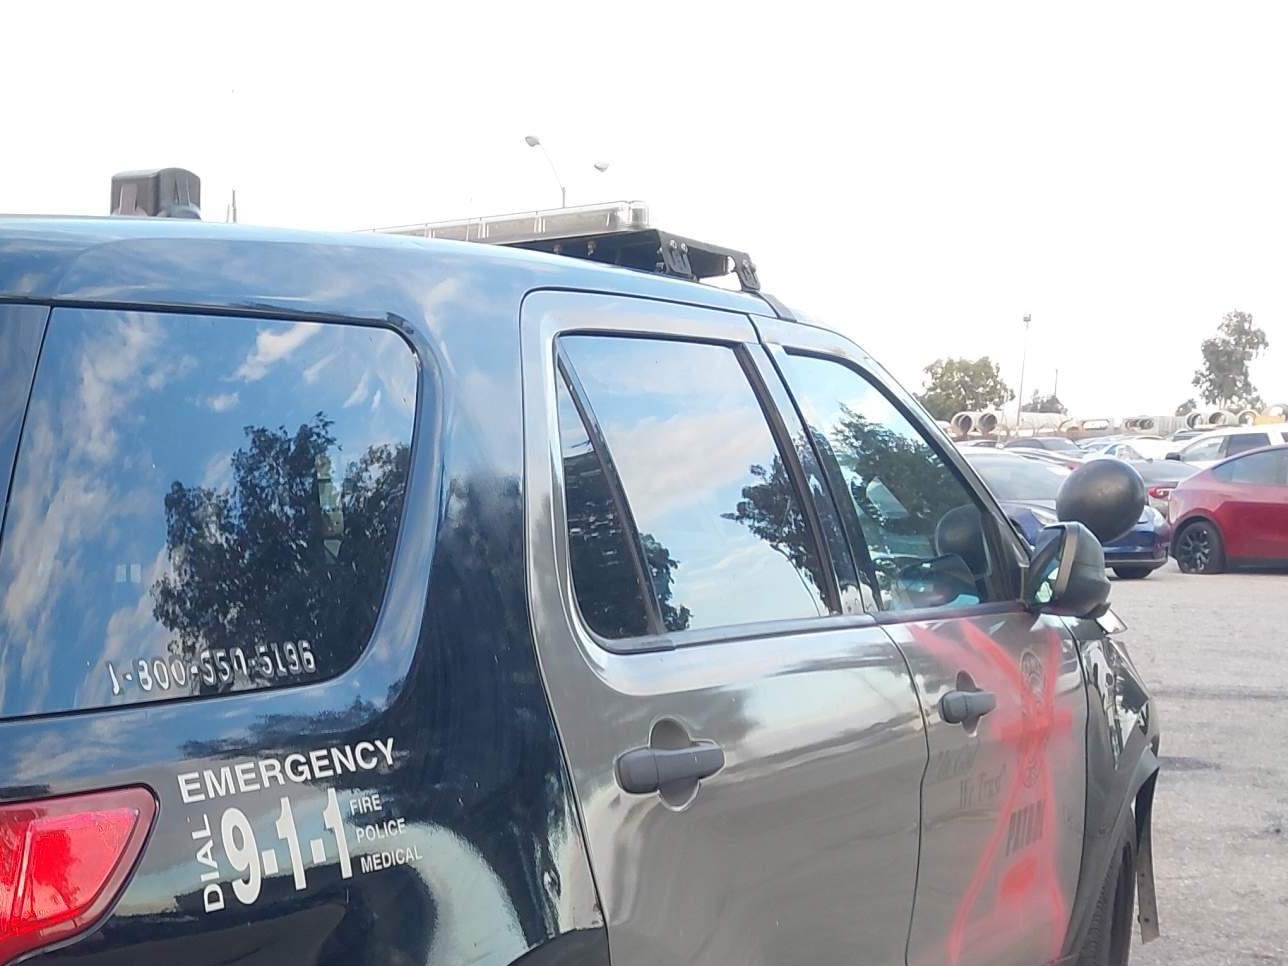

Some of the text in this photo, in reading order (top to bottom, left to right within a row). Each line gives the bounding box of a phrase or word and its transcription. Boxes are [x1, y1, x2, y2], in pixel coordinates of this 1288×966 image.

[177, 737, 395, 804] EMERGENCY
[349, 794, 383, 816] FIRE
[354, 817, 407, 844] POLICE
[191, 813, 226, 913] DIAL
[360, 847, 424, 874] MEDICAL
